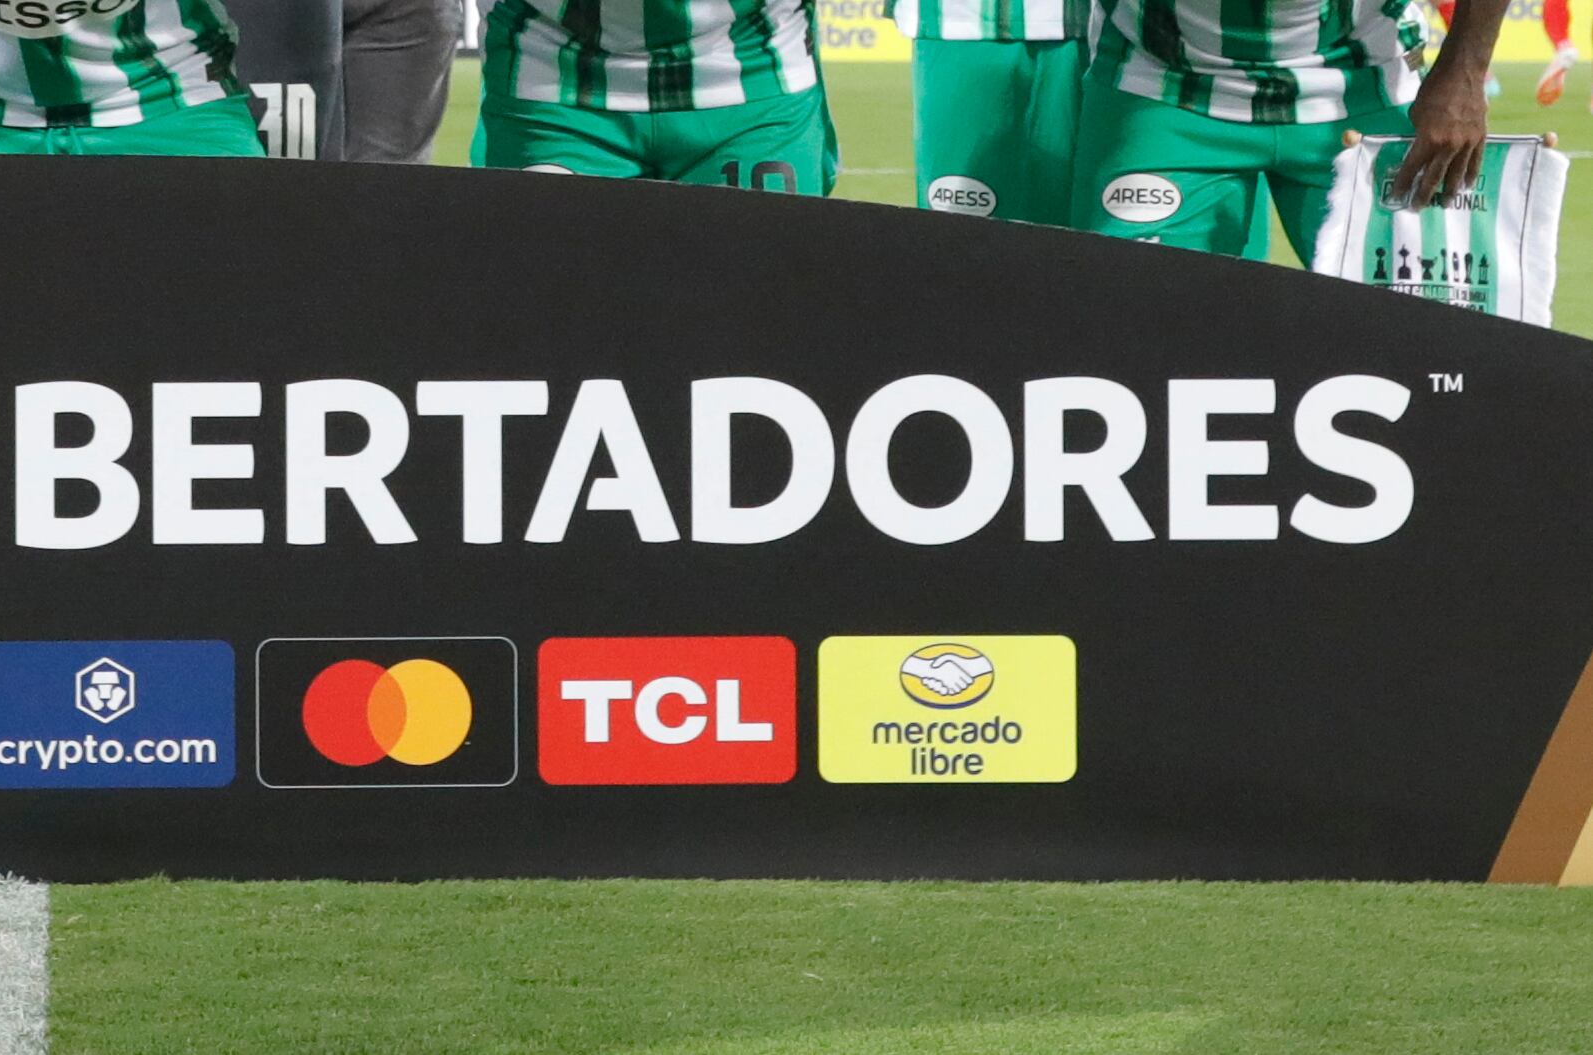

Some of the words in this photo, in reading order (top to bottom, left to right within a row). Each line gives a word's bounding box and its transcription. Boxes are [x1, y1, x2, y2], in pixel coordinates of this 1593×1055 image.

[932, 186, 991, 208] ARESS
[1106, 187, 1175, 206] ARESS
[560, 676, 774, 745] TCL
[873, 716, 1022, 745] mercado
[911, 747, 984, 776] libre
